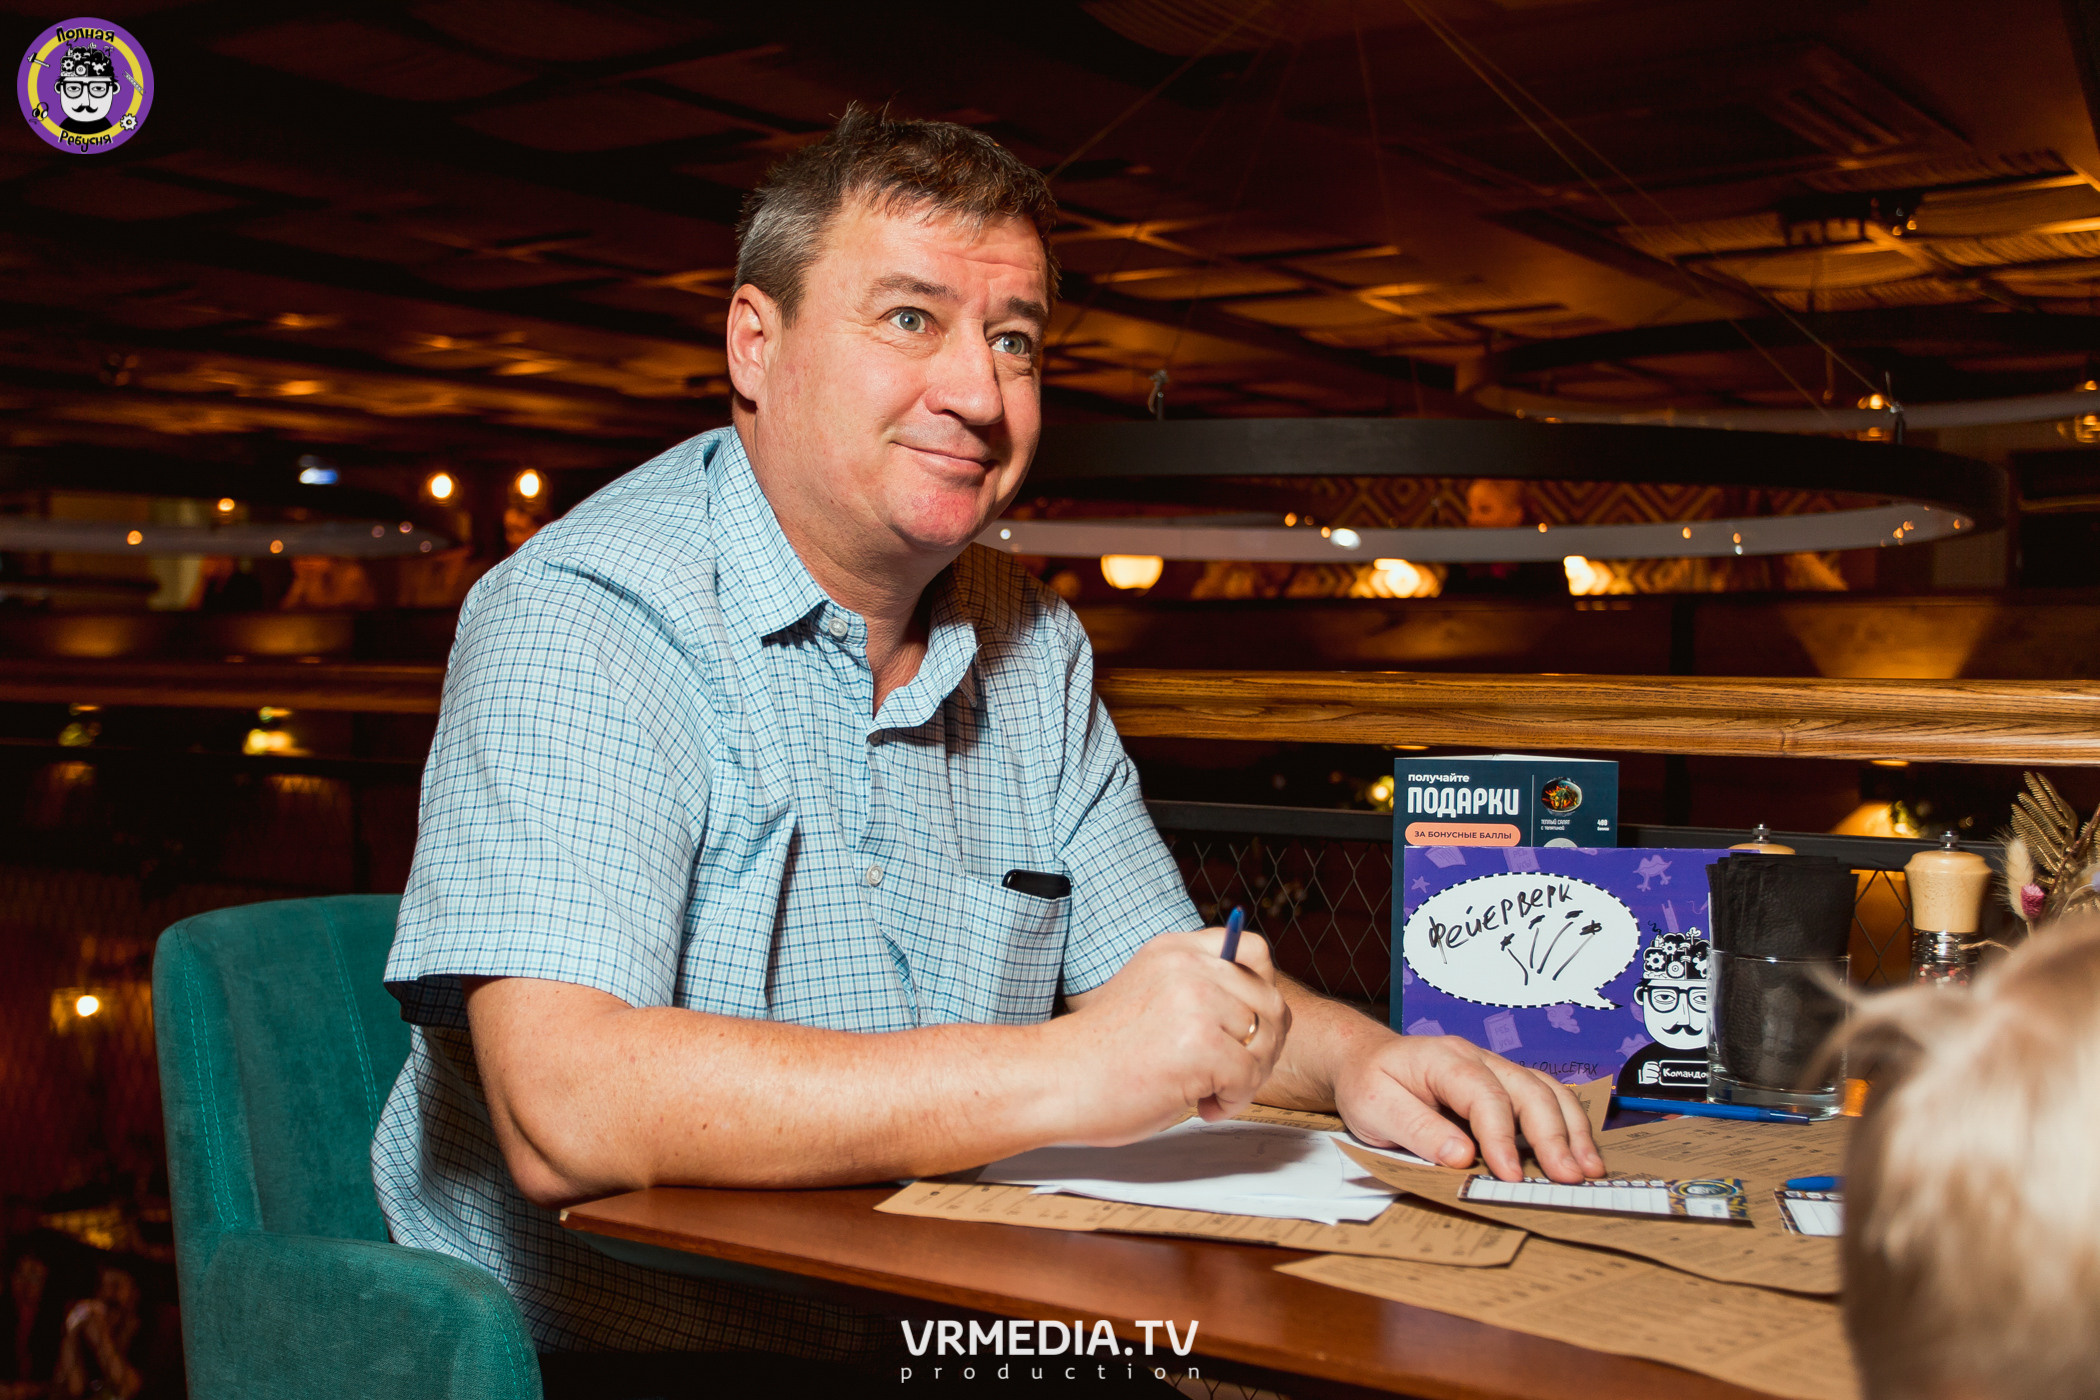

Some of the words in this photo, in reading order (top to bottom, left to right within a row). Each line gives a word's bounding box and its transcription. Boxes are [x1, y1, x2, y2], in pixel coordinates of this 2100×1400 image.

[1408, 773, 1470, 784] получайте
[1407, 787, 1520, 818] ПОДАРКИ
[1414, 830, 1426, 838] ЗА
[1428, 831, 1477, 839] БОНУСНЫЕ
